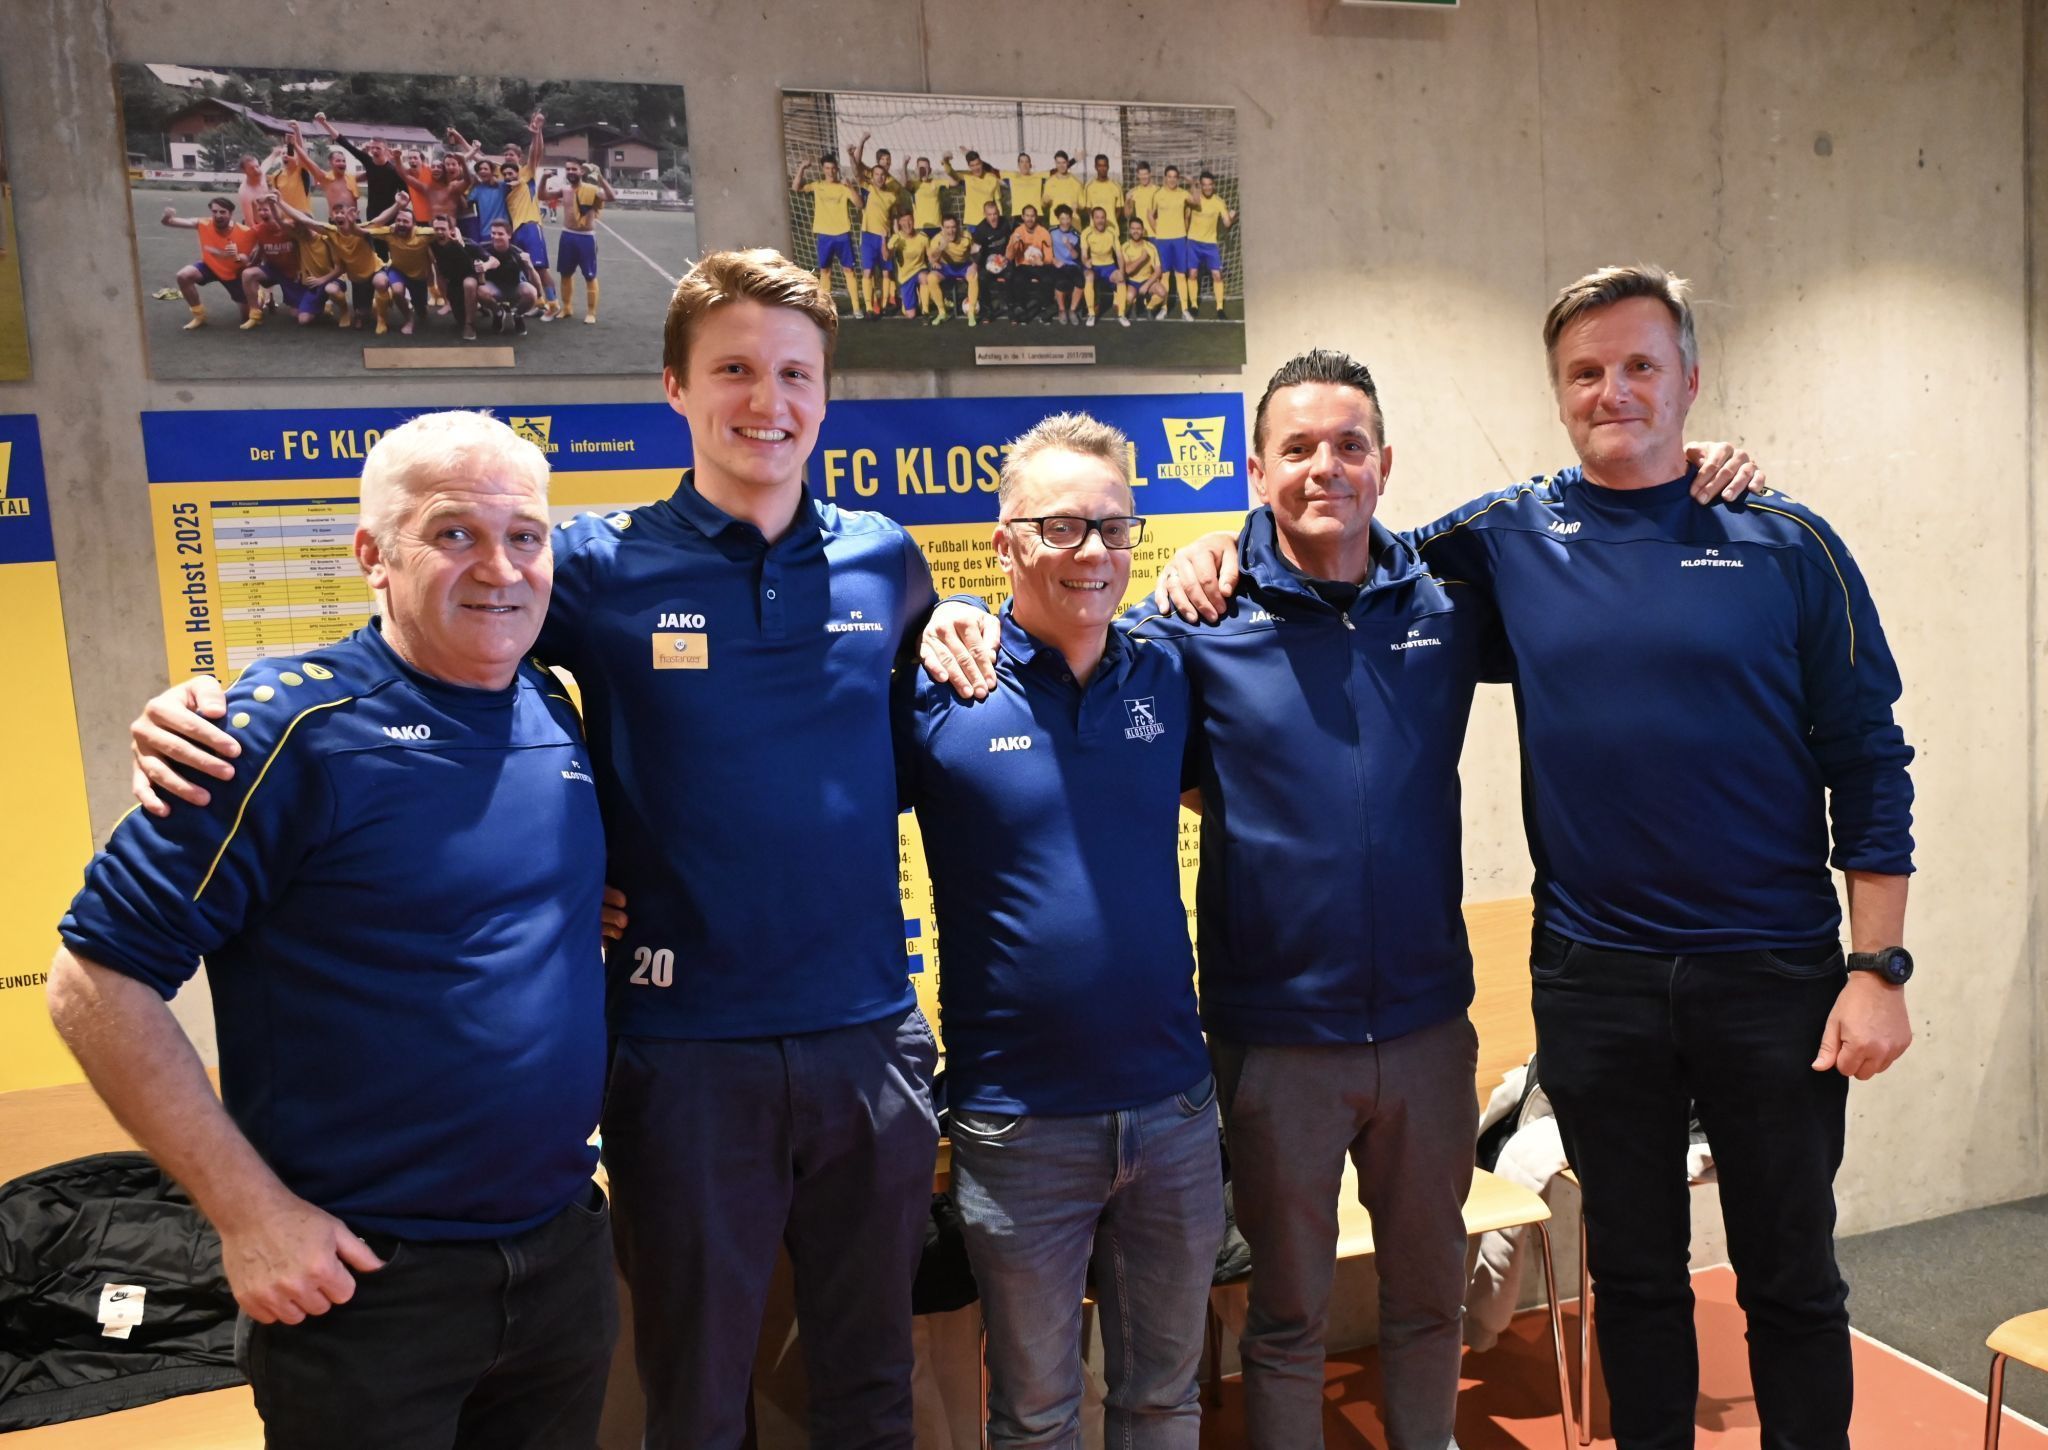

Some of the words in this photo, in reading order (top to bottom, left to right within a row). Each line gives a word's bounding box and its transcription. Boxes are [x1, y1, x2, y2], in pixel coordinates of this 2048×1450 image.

[250, 447, 275, 460] Der
[282, 430, 319, 460] FC
[570, 439, 635, 453] informiert
[1180, 445, 1197, 461] FC
[824, 448, 879, 497] FC
[1160, 463, 1232, 477] KLOSTERTAL
[173, 502, 202, 554] 2025
[1548, 520, 1581, 534] JAKO
[928, 540, 969, 553] Fußball
[1706, 548, 1719, 556] FC
[1130, 549, 1154, 561] eine
[1157, 547, 1170, 559] FC
[963, 558, 982, 570] des
[1680, 559, 1744, 567] KLOSTERTAL
[1130, 568, 1153, 579] nau,
[942, 577, 955, 589] FC
[959, 575, 1006, 588] Dornbirn
[181, 562, 210, 632] Herbst
[657, 613, 706, 628] JAKO
[850, 611, 862, 619] FC
[826, 623, 883, 632] KLOSTERTAL
[1407, 630, 1420, 638] FC
[1390, 638, 1441, 650] KLOSTERTAL
[1134, 715, 1146, 726] FC
[989, 735, 1032, 752] JAKO
[1180, 839, 1190, 851] LK
[629, 946, 675, 988] 20
